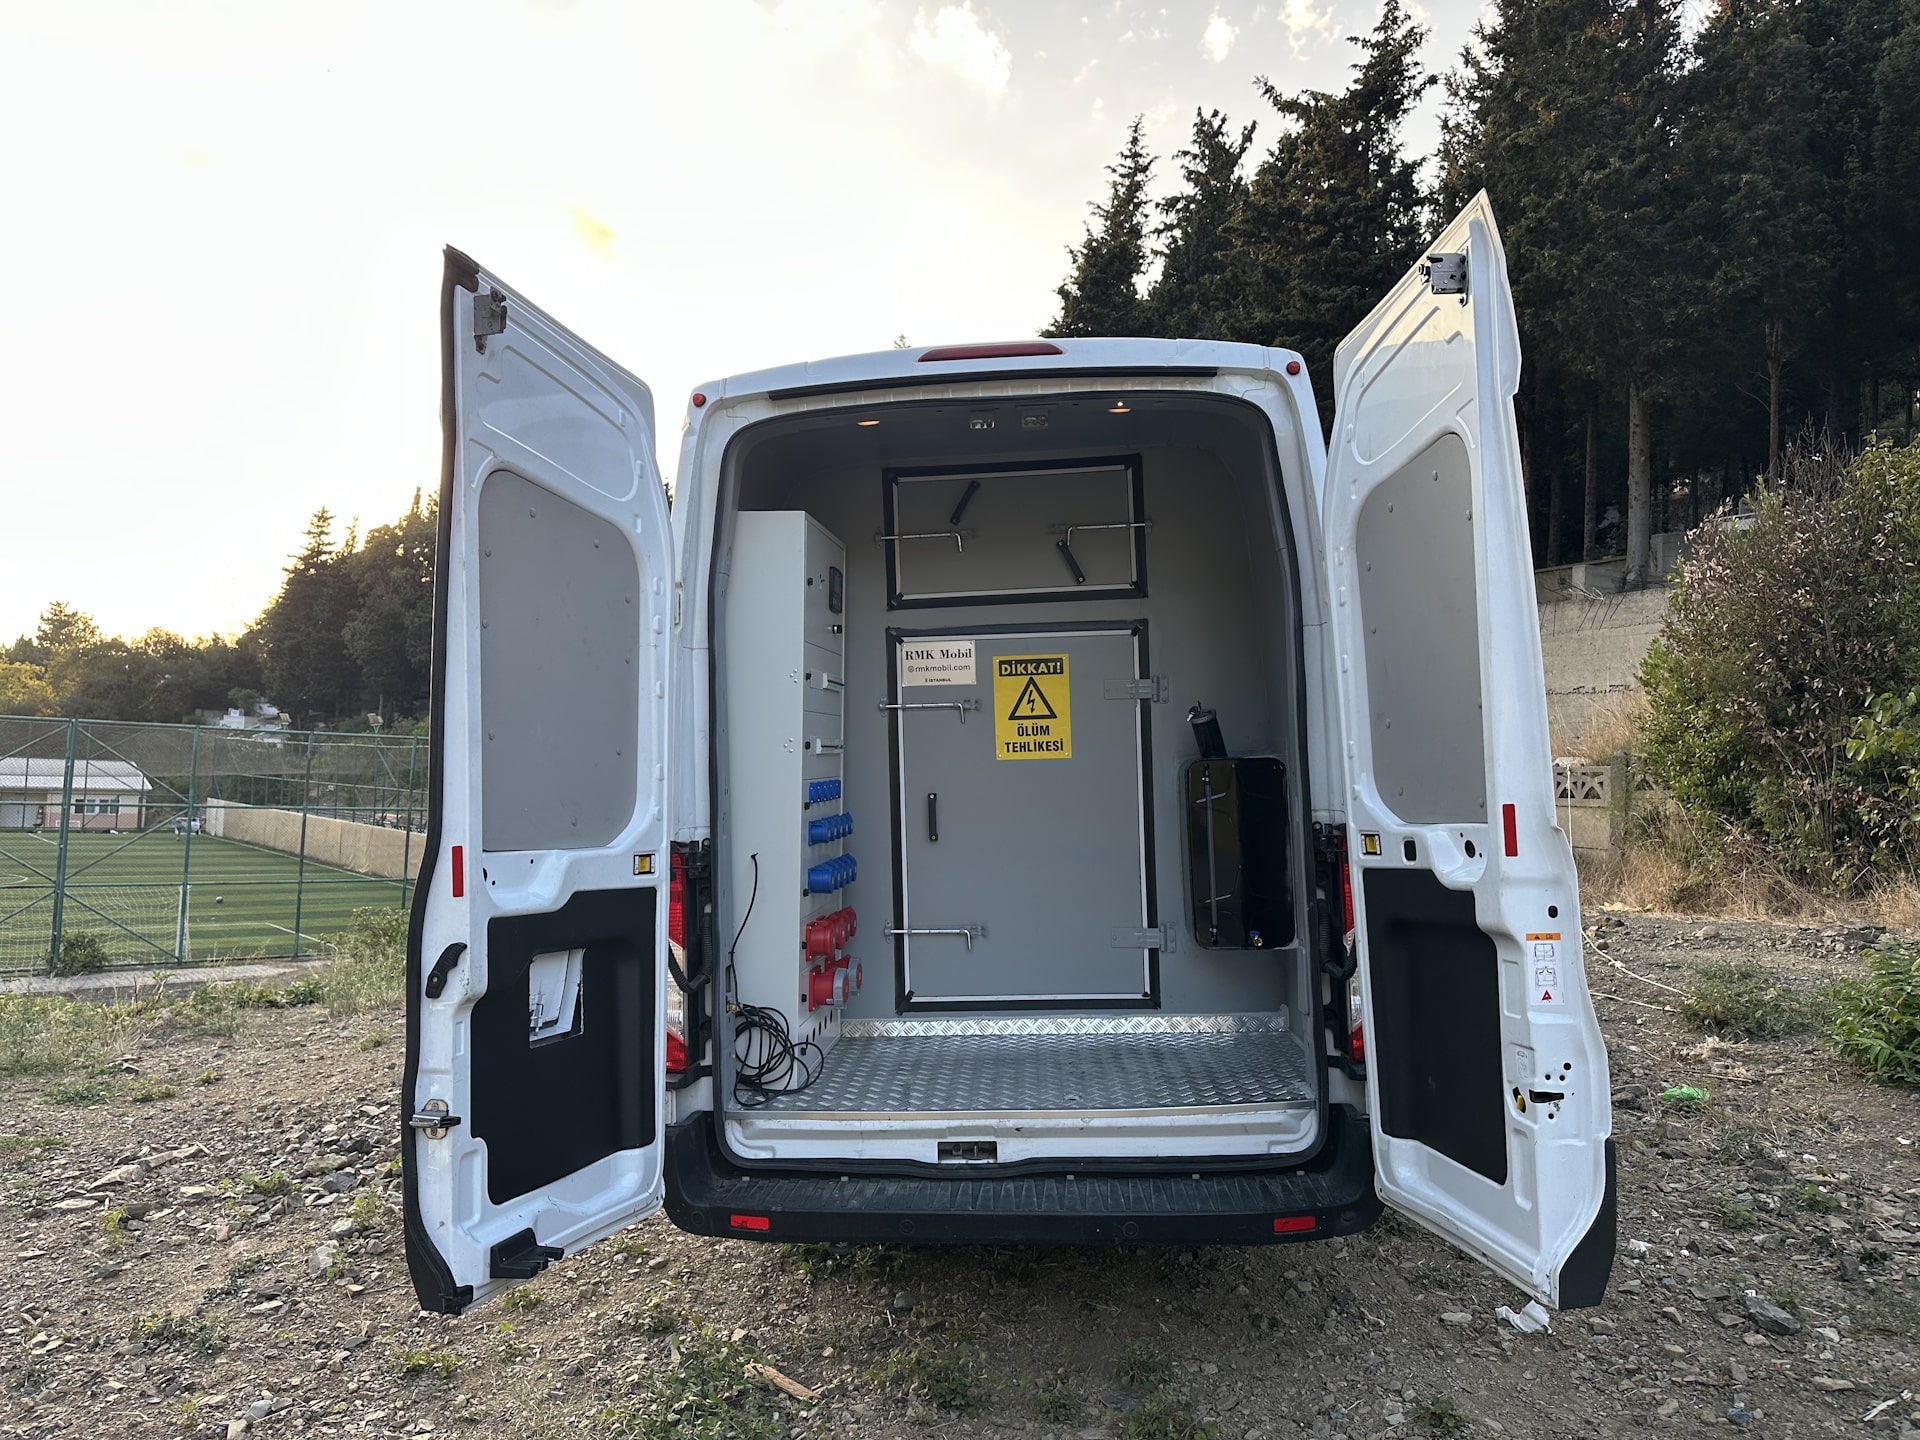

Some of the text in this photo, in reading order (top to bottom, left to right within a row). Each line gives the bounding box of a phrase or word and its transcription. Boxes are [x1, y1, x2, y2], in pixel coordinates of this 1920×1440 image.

[905, 648, 972, 660] RMK Mobil
[1001, 660, 1061, 675] DİKKAT!
[1017, 722, 1050, 737] ÖLÜM
[1005, 738, 1064, 753] TEHLİKESİ
